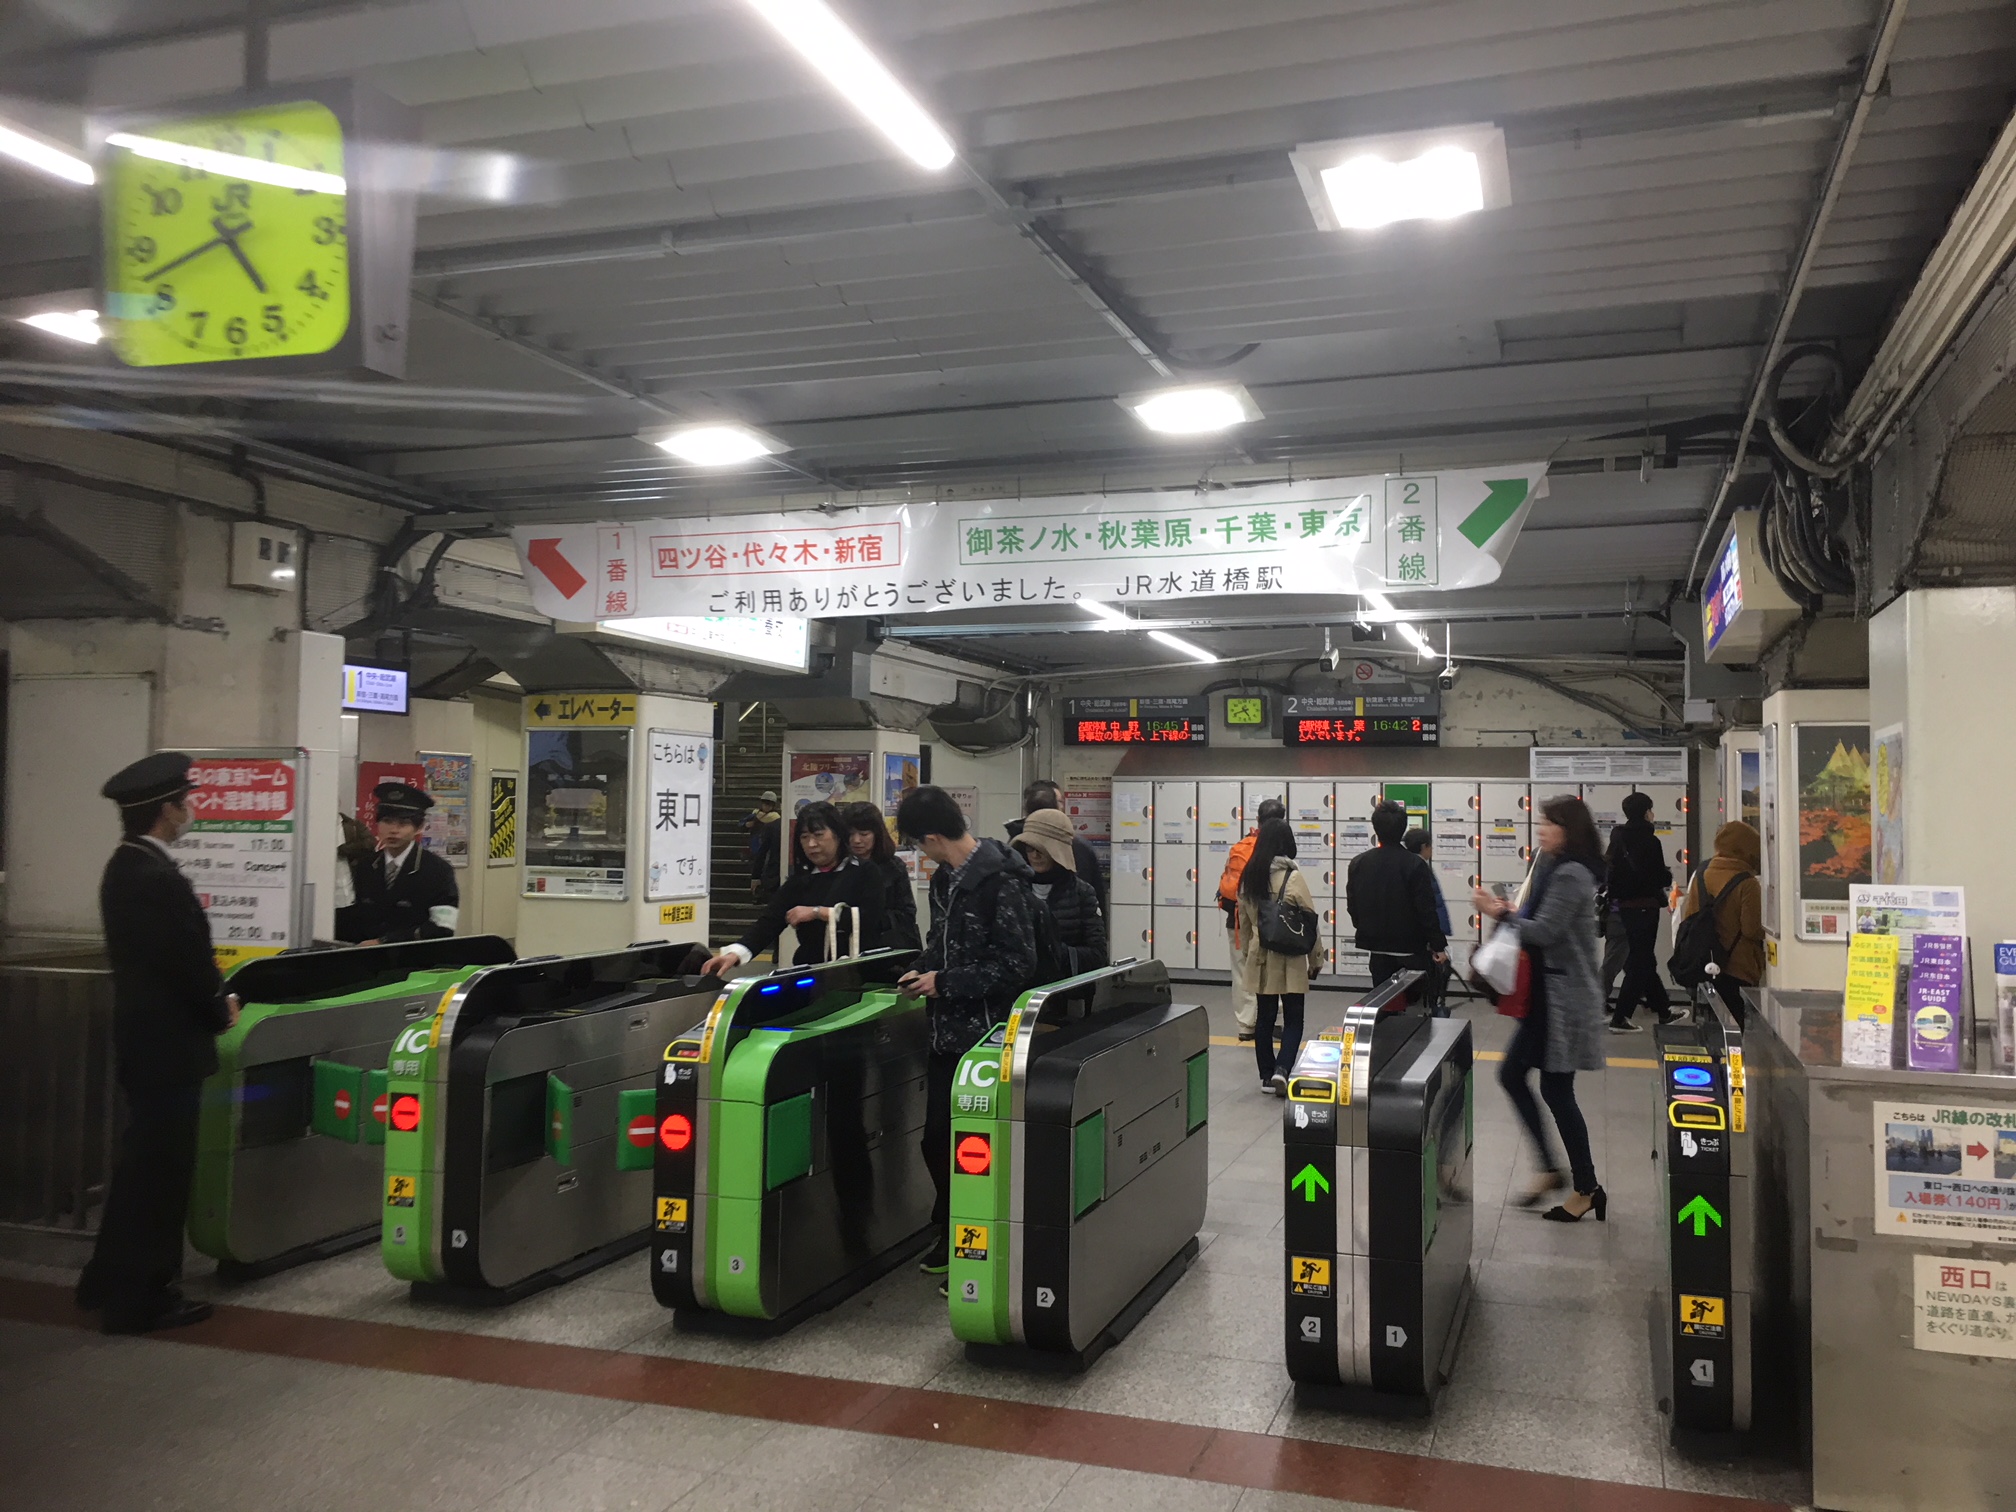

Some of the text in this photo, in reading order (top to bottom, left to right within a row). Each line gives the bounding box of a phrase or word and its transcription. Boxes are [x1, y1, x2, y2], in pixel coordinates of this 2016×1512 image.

[141, 183, 183, 215] 10
[312, 216, 336, 246] 3
[297, 270, 322, 298] 4
[188, 310, 209, 339] 7
[263, 304, 286, 333] 5
[226, 316, 248, 345] 6
[966, 507, 1363, 556] 御茶ノ水・秋葉原・千葉・東京
[1398, 483, 1427, 581] 2番線
[658, 534, 883, 571] 四ツ谷・代々木・新宿
[606, 532, 628, 613] 1番線
[709, 566, 1283, 613] ご利用ありがとうございました。 JR水道橋駅
[558, 697, 634, 720] エレベーター
[1069, 699, 1076, 714] 1
[1287, 697, 1298, 713] 2
[1146, 721, 1179, 731] 16:45
[1183, 721, 1189, 731] 1
[1373, 720, 1408, 731] 16:42
[1412, 719, 1420, 731] 2
[653, 743, 695, 764] こちらは
[656, 788, 701, 832] 東口
[1918, 987, 1951, 996] JR-EAST
[1921, 995, 1947, 1003] GUIDE
[395, 1028, 431, 1053] IC
[958, 1060, 1000, 1088] IC
[957, 1094, 989, 1112] 専用
[1893, 1112, 1926, 1121] こちらは
[1700, 1138, 1719, 1146] きっぷ
[666, 1253, 675, 1264] 4
[732, 1259, 740, 1271] 3
[966, 1283, 974, 1295] 3
[1040, 1291, 1049, 1304] 2
[1308, 1321, 1317, 1333] 2
[1391, 1331, 1399, 1343] 1
[1700, 1364, 1707, 1377] 1
